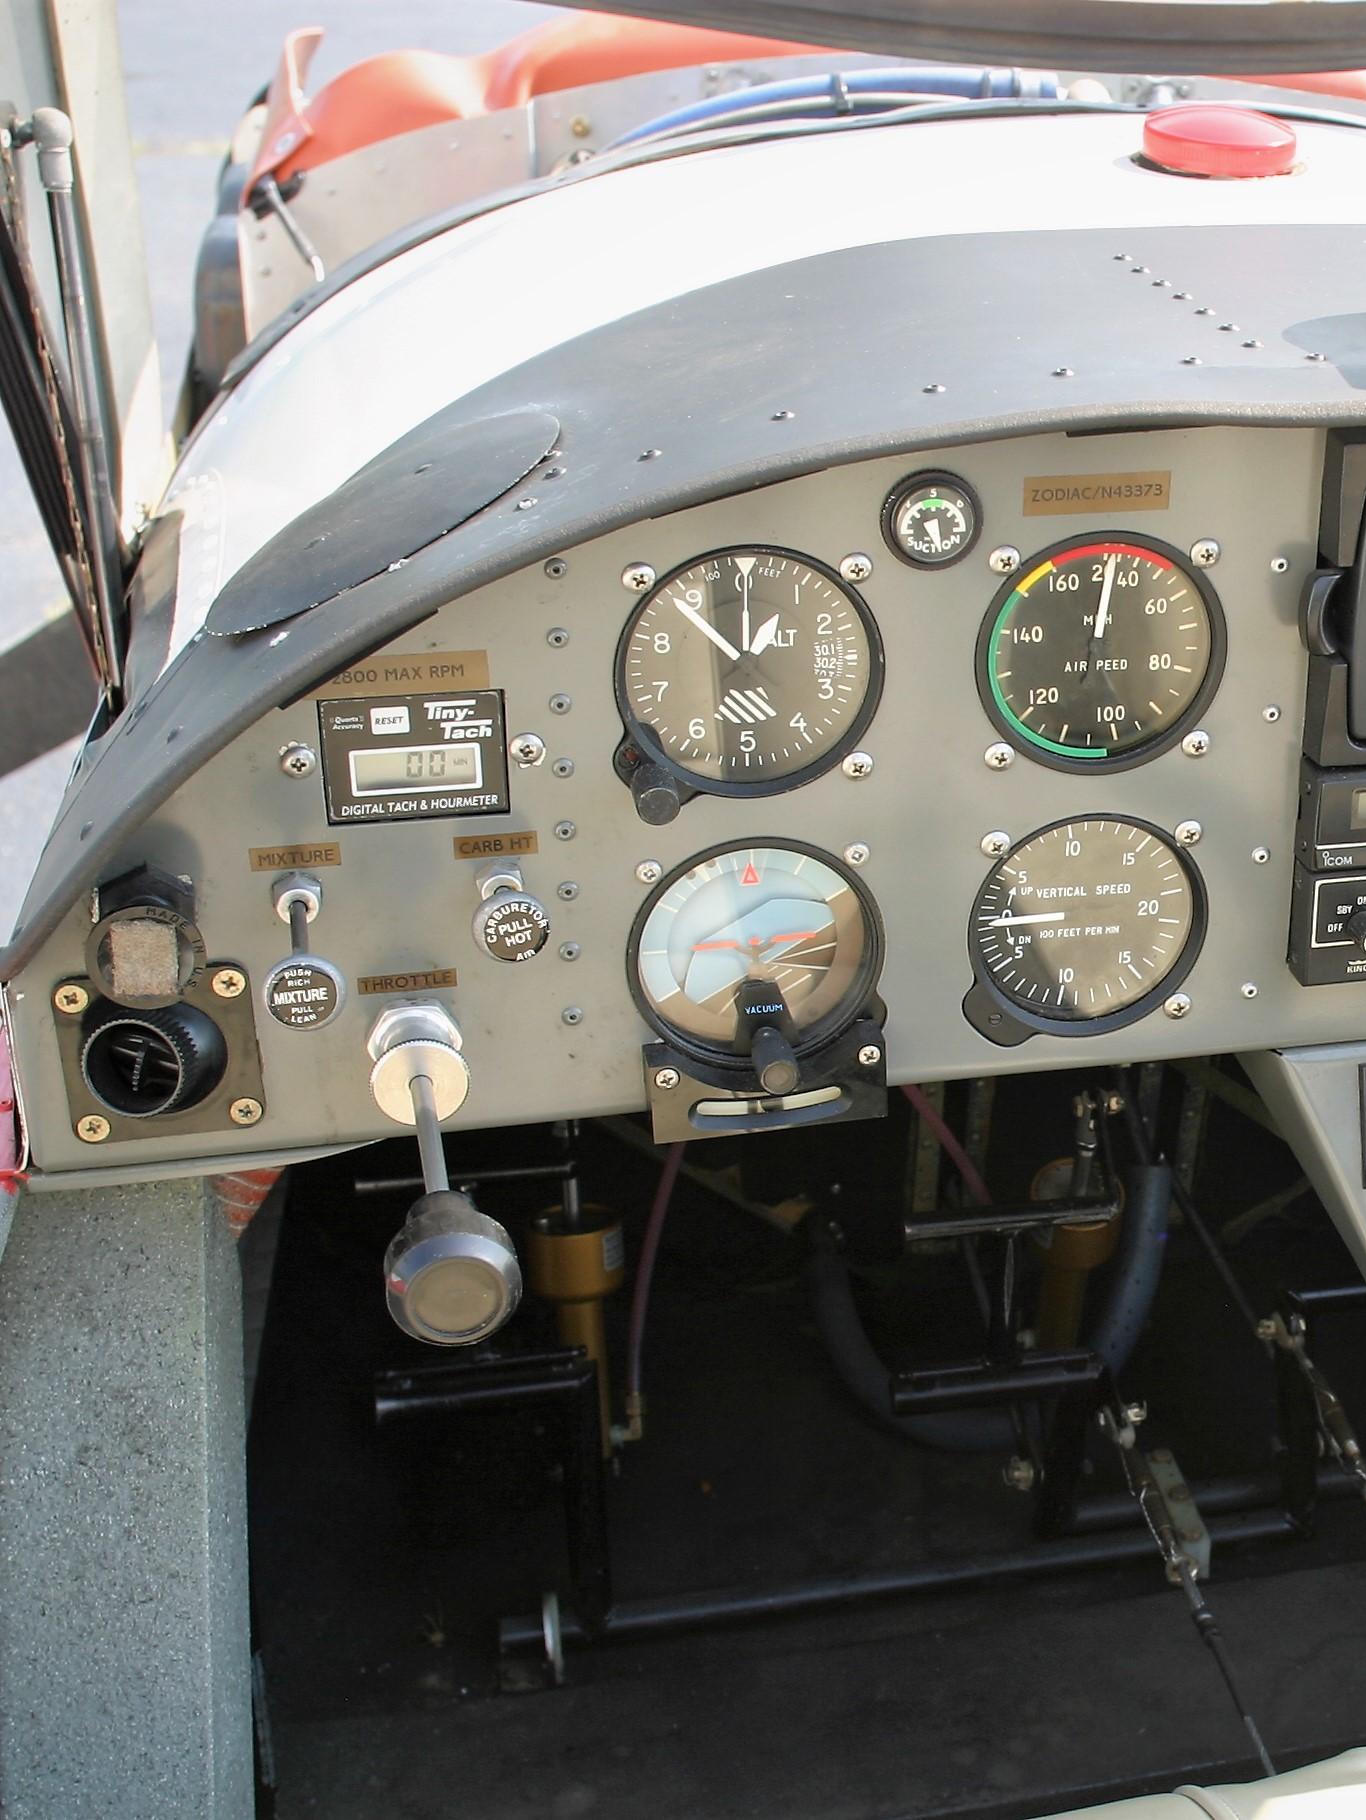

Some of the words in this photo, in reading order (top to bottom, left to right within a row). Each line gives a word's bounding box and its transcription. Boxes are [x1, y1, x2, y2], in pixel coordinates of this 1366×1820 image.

[929, 488, 937, 498] 5
[1031, 483, 1163, 503] ZODIAC/N43373
[907, 534, 960, 554] SUCTON
[758, 566, 782, 578] FEET
[1116, 571, 1139, 588] 40
[1049, 573, 1080, 592] 160
[685, 589, 703, 610] 9
[794, 584, 800, 604] 1
[1144, 598, 1167, 615] 60
[816, 613, 833, 635] 2
[1083, 613, 1112, 626] MH
[653, 632, 671, 653] 8
[1014, 625, 1043, 643] 140
[1064, 660, 1087, 673] AIR
[1149, 653, 1171, 671] 80
[332, 669, 378, 685] 2800
[385, 666, 423, 682] MAX
[429, 663, 465, 679] RPM
[652, 681, 669, 702] 7
[817, 678, 834, 699] 3
[1029, 687, 1059, 705] 120
[374, 716, 404, 726] RESET
[789, 711, 808, 732] 4
[1096, 705, 1125, 723] 100
[440, 718, 493, 740] Tach
[688, 718, 706, 739] 6
[740, 730, 757, 752] 5
[453, 758, 468, 767] MIN
[341, 803, 385, 816] DIGITAL
[388, 801, 417, 813] TACH
[419, 799, 428, 811] &
[431, 794, 498, 810] HOURMETER
[459, 838, 504, 855] CARB
[513, 836, 534, 850] HT
[1065, 841, 1080, 857] 10
[258, 848, 334, 867] MIXTURE
[1122, 853, 1135, 866] 15
[1018, 871, 1027, 883] 5
[1020, 886, 1034, 896] UP
[1036, 886, 1087, 899] VERTICAL
[1095, 883, 1131, 895] SPEED
[1137, 900, 1159, 916] 20
[145, 907, 187, 930] MADE
[191, 939, 205, 954] IN
[486, 903, 549, 943] CARBURETOR
[498, 918, 533, 936] PULL
[1039, 929, 1054, 939] 100
[1057, 927, 1081, 938] FEET
[1085, 926, 1103, 936] PER
[1105, 925, 1120, 934] MIN
[1327, 923, 1344, 933] OFF
[504, 929, 532, 947] HOT
[1014, 945, 1024, 959] 5
[1118, 951, 1131, 964] 15
[283, 968, 312, 979] PUSH
[361, 972, 452, 993] THROTTLE
[1058, 968, 1074, 983] 10
[287, 979, 311, 987] RICH
[273, 987, 329, 1006] MIXTURE
[291, 1005, 314, 1014] PULL
[291, 1013, 317, 1023] LEAN
[744, 1003, 783, 1015] VACUUM
